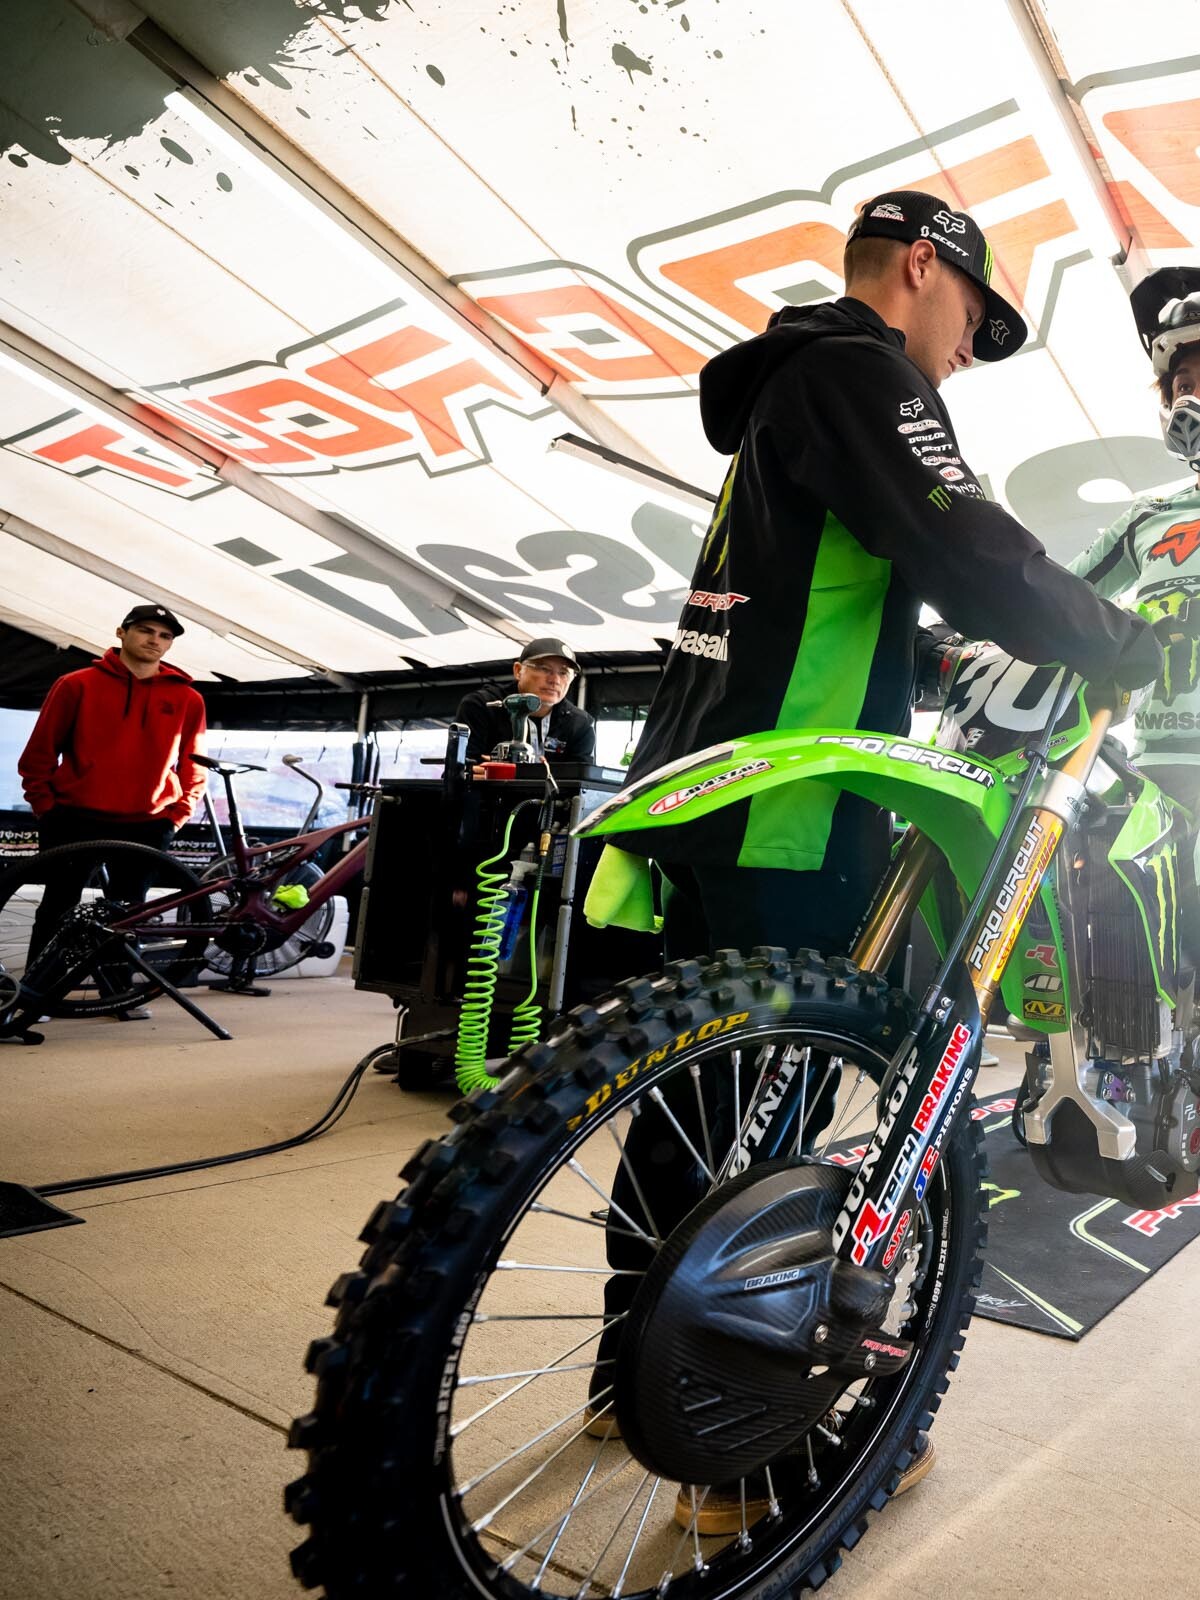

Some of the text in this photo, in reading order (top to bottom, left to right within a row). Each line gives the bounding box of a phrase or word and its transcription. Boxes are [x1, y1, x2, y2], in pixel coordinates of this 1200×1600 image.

[929, 232, 969, 257] SCOTT
[908, 432, 945, 444] DUNLOP
[921, 443, 953, 453] SCOTT
[1164, 576, 1197, 587] FOX
[887, 742, 996, 789] CIRCUIT
[969, 910, 1003, 971] PRO
[996, 815, 1044, 913] CIRCUIT
[1016, 831, 1057, 924] SHOWA
[585, 1012, 750, 1118] DUNLOP
[912, 1023, 973, 1137] BRAKING
[934, 1067, 973, 1149] PISTONS
[832, 1046, 921, 1254] DUNLOP
[882, 1208, 912, 1269] GUTS
[935, 1238, 948, 1281] EXCEL
[744, 1268, 800, 1291] BRAKING
[438, 1352, 458, 1414] EXCEL
